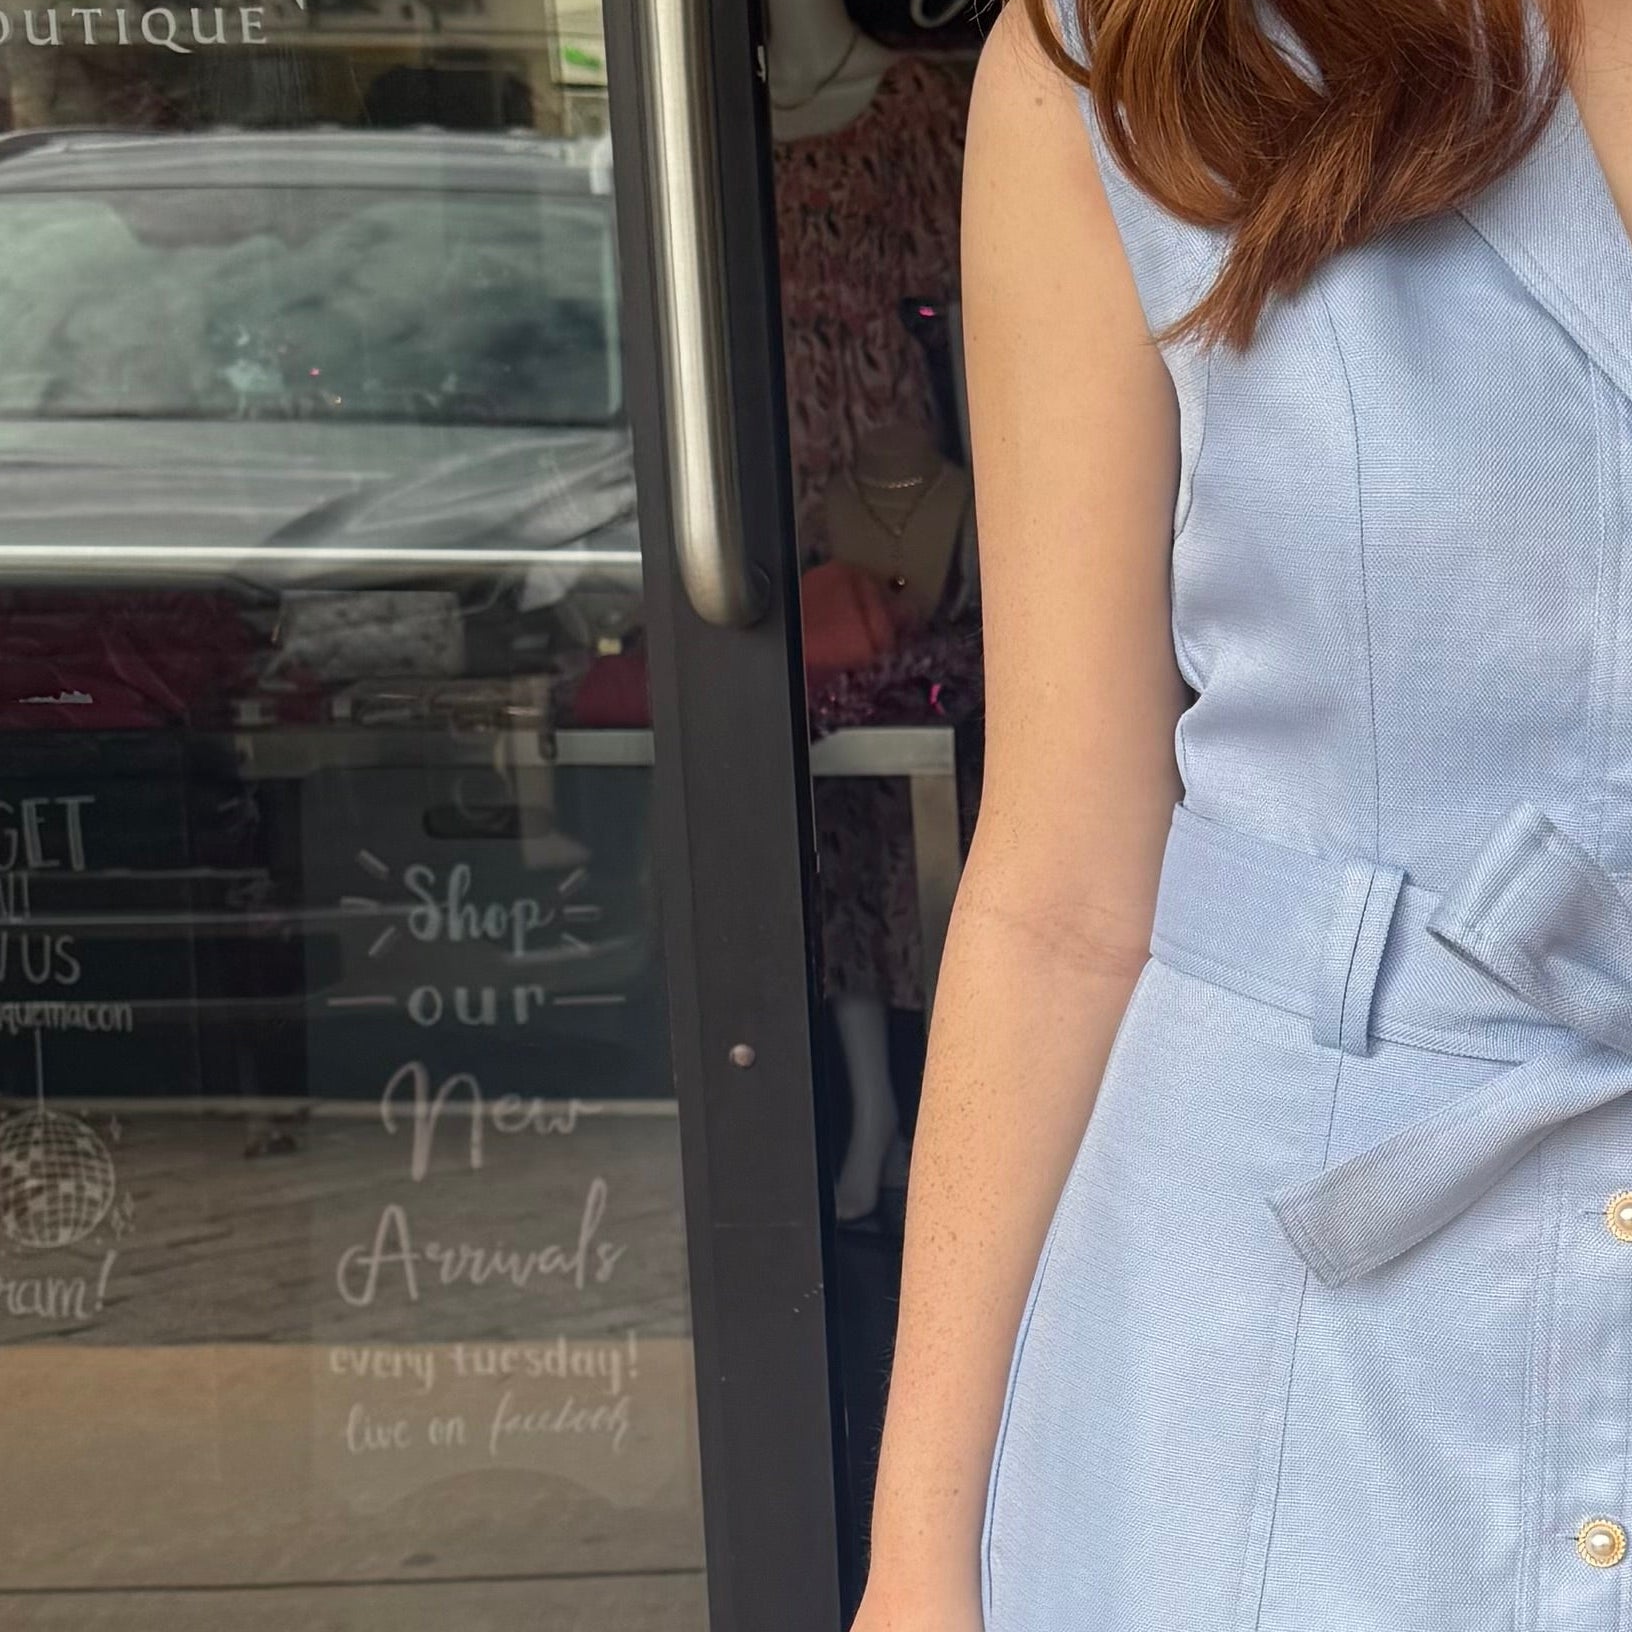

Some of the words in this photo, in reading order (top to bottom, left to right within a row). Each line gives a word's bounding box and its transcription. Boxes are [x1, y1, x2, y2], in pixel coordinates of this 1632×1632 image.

[0, 6, 267, 54] UTIQUE
[403, 863, 555, 957] Shop
[20, 933, 82, 986] US
[405, 984, 546, 1027] our
[380, 1062, 598, 1181] New
[336, 1176, 628, 1308] Arrivals
[328, 1345, 436, 1396] every
[451, 1328, 640, 1396] tuesday!
[345, 1402, 412, 1455] live
[427, 1414, 468, 1447] on
